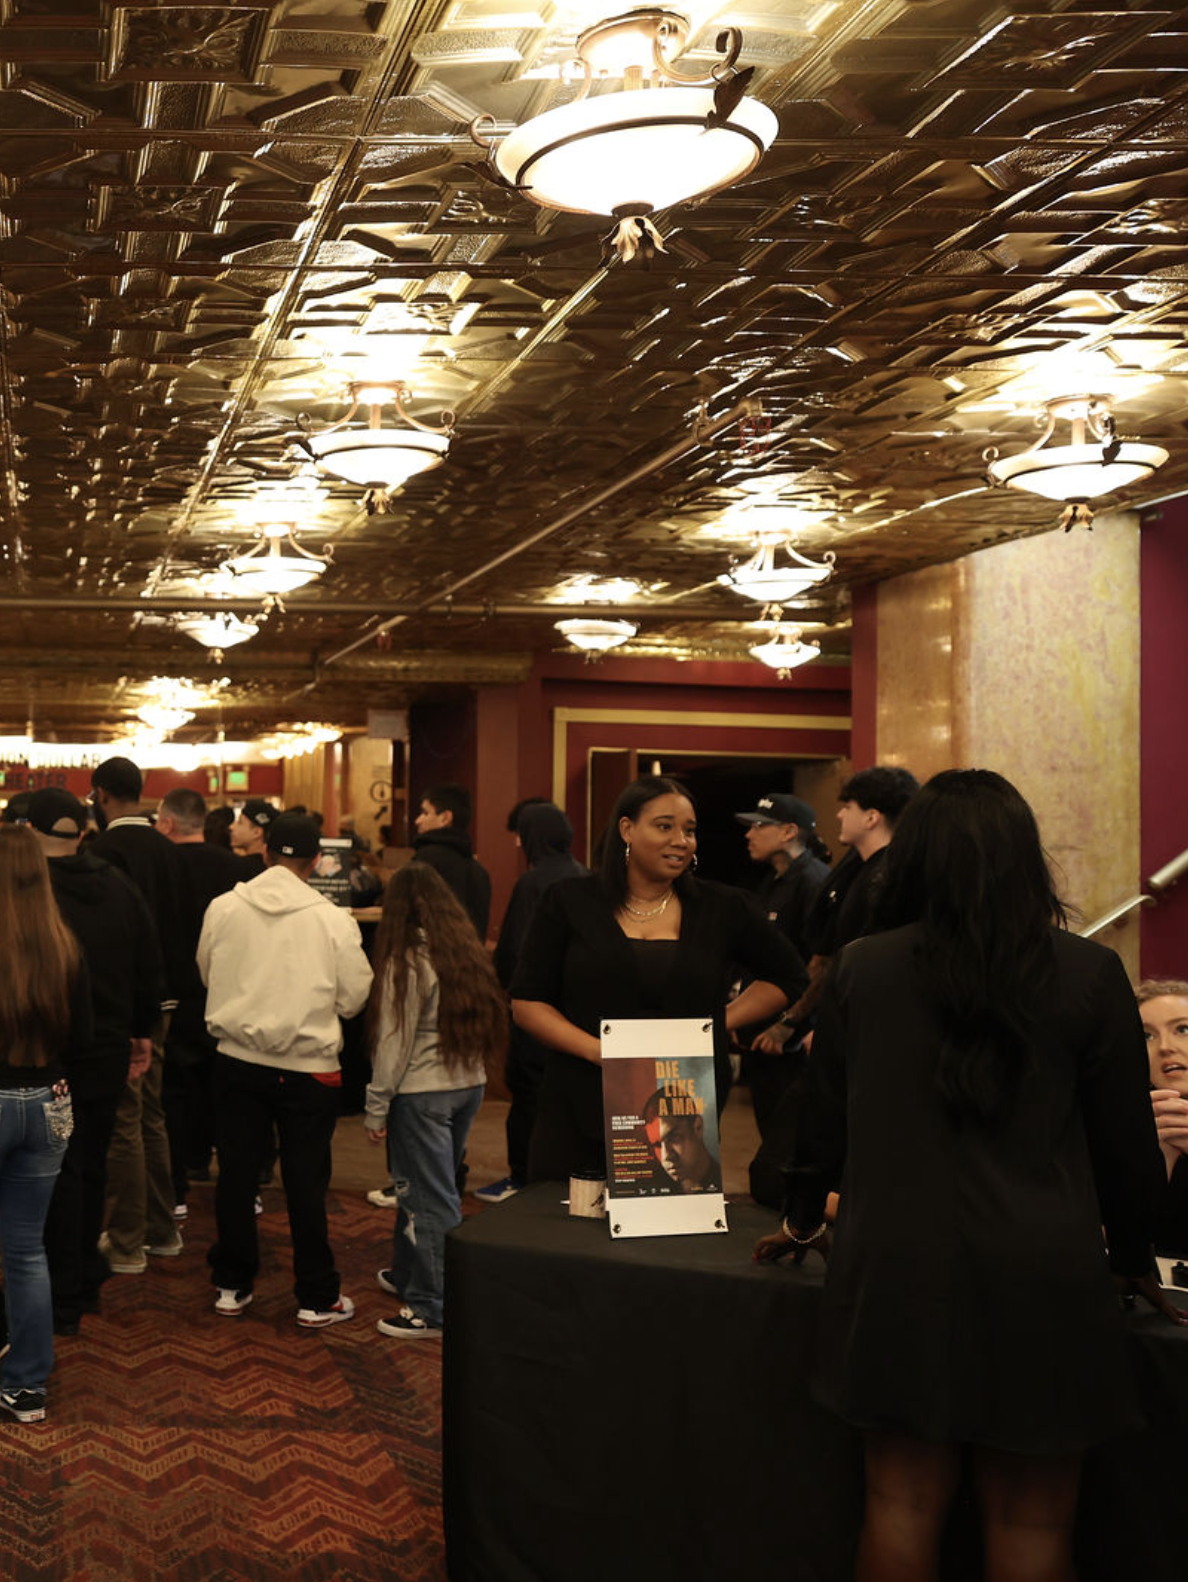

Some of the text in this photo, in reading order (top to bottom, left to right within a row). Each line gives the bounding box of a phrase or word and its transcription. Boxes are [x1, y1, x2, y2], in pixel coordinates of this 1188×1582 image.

[655, 1060, 679, 1079] DIE
[664, 1079, 696, 1098] LIKE
[658, 1097, 704, 1117] A MAN
